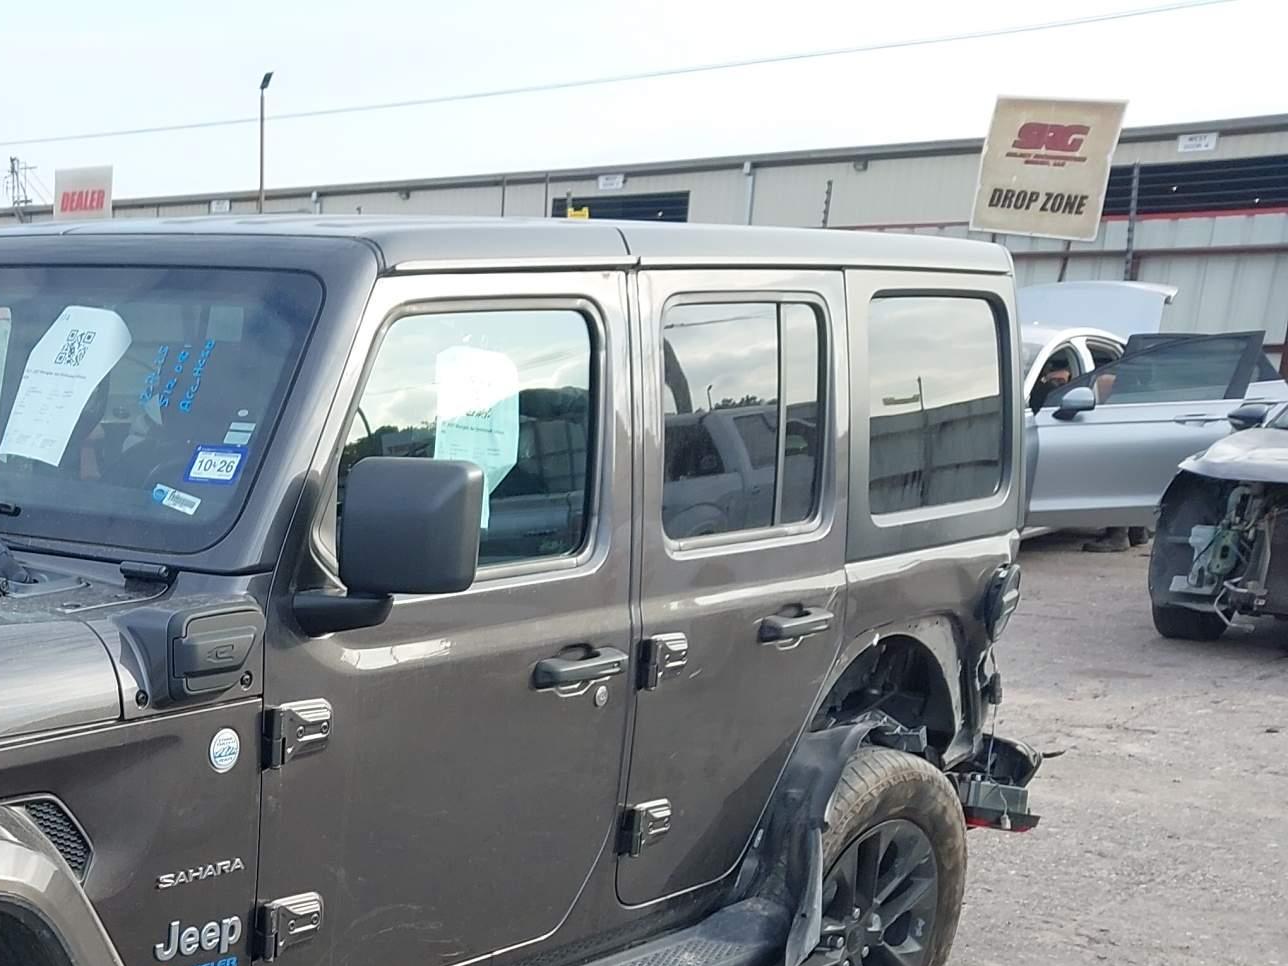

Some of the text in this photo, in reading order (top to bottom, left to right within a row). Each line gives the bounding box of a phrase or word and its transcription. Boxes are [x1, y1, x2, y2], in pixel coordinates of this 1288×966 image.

[988, 187, 1090, 216] DROP ZONE
[157, 857, 245, 890] SAHARA
[154, 915, 243, 962] Jeep
